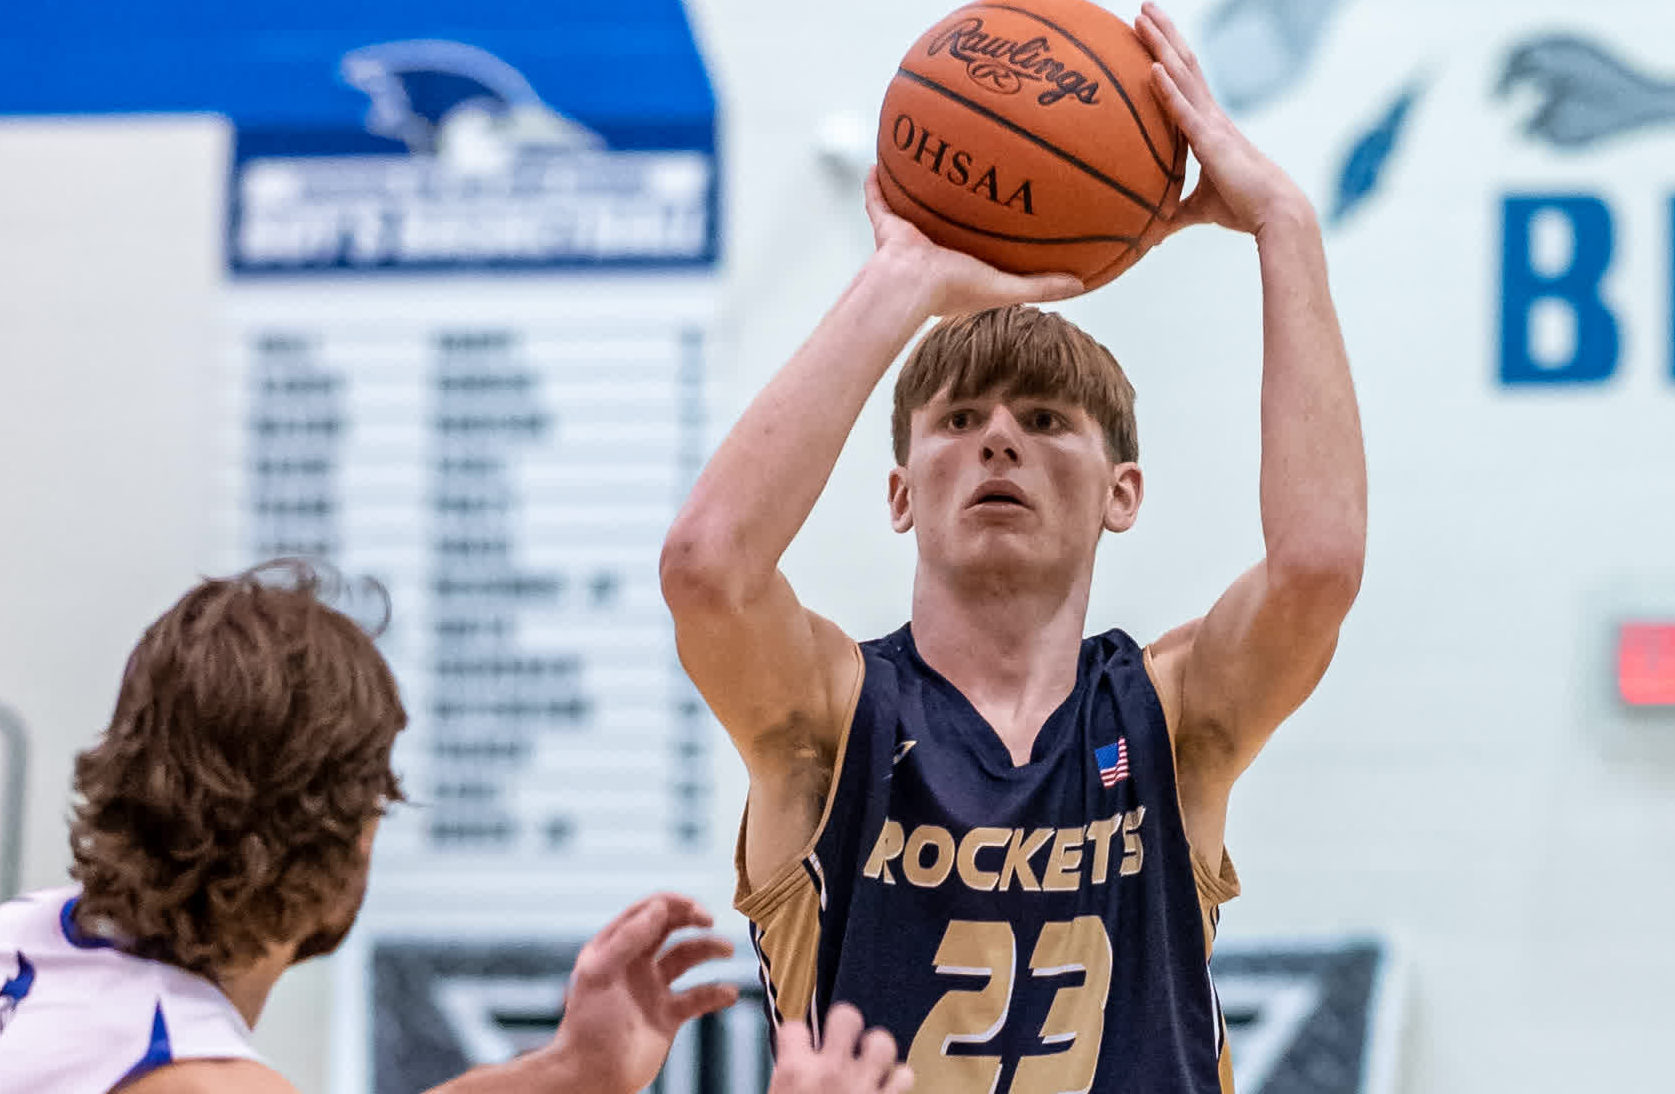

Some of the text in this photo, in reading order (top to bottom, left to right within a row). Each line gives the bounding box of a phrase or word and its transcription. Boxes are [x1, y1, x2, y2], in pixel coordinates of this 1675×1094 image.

[928, 17, 1099, 106] Rawlings
[892, 113, 1035, 215] OHSAA
[1500, 193, 1675, 387] B
[863, 805, 1147, 892] ROCKETS
[905, 914, 1113, 1094] 23
